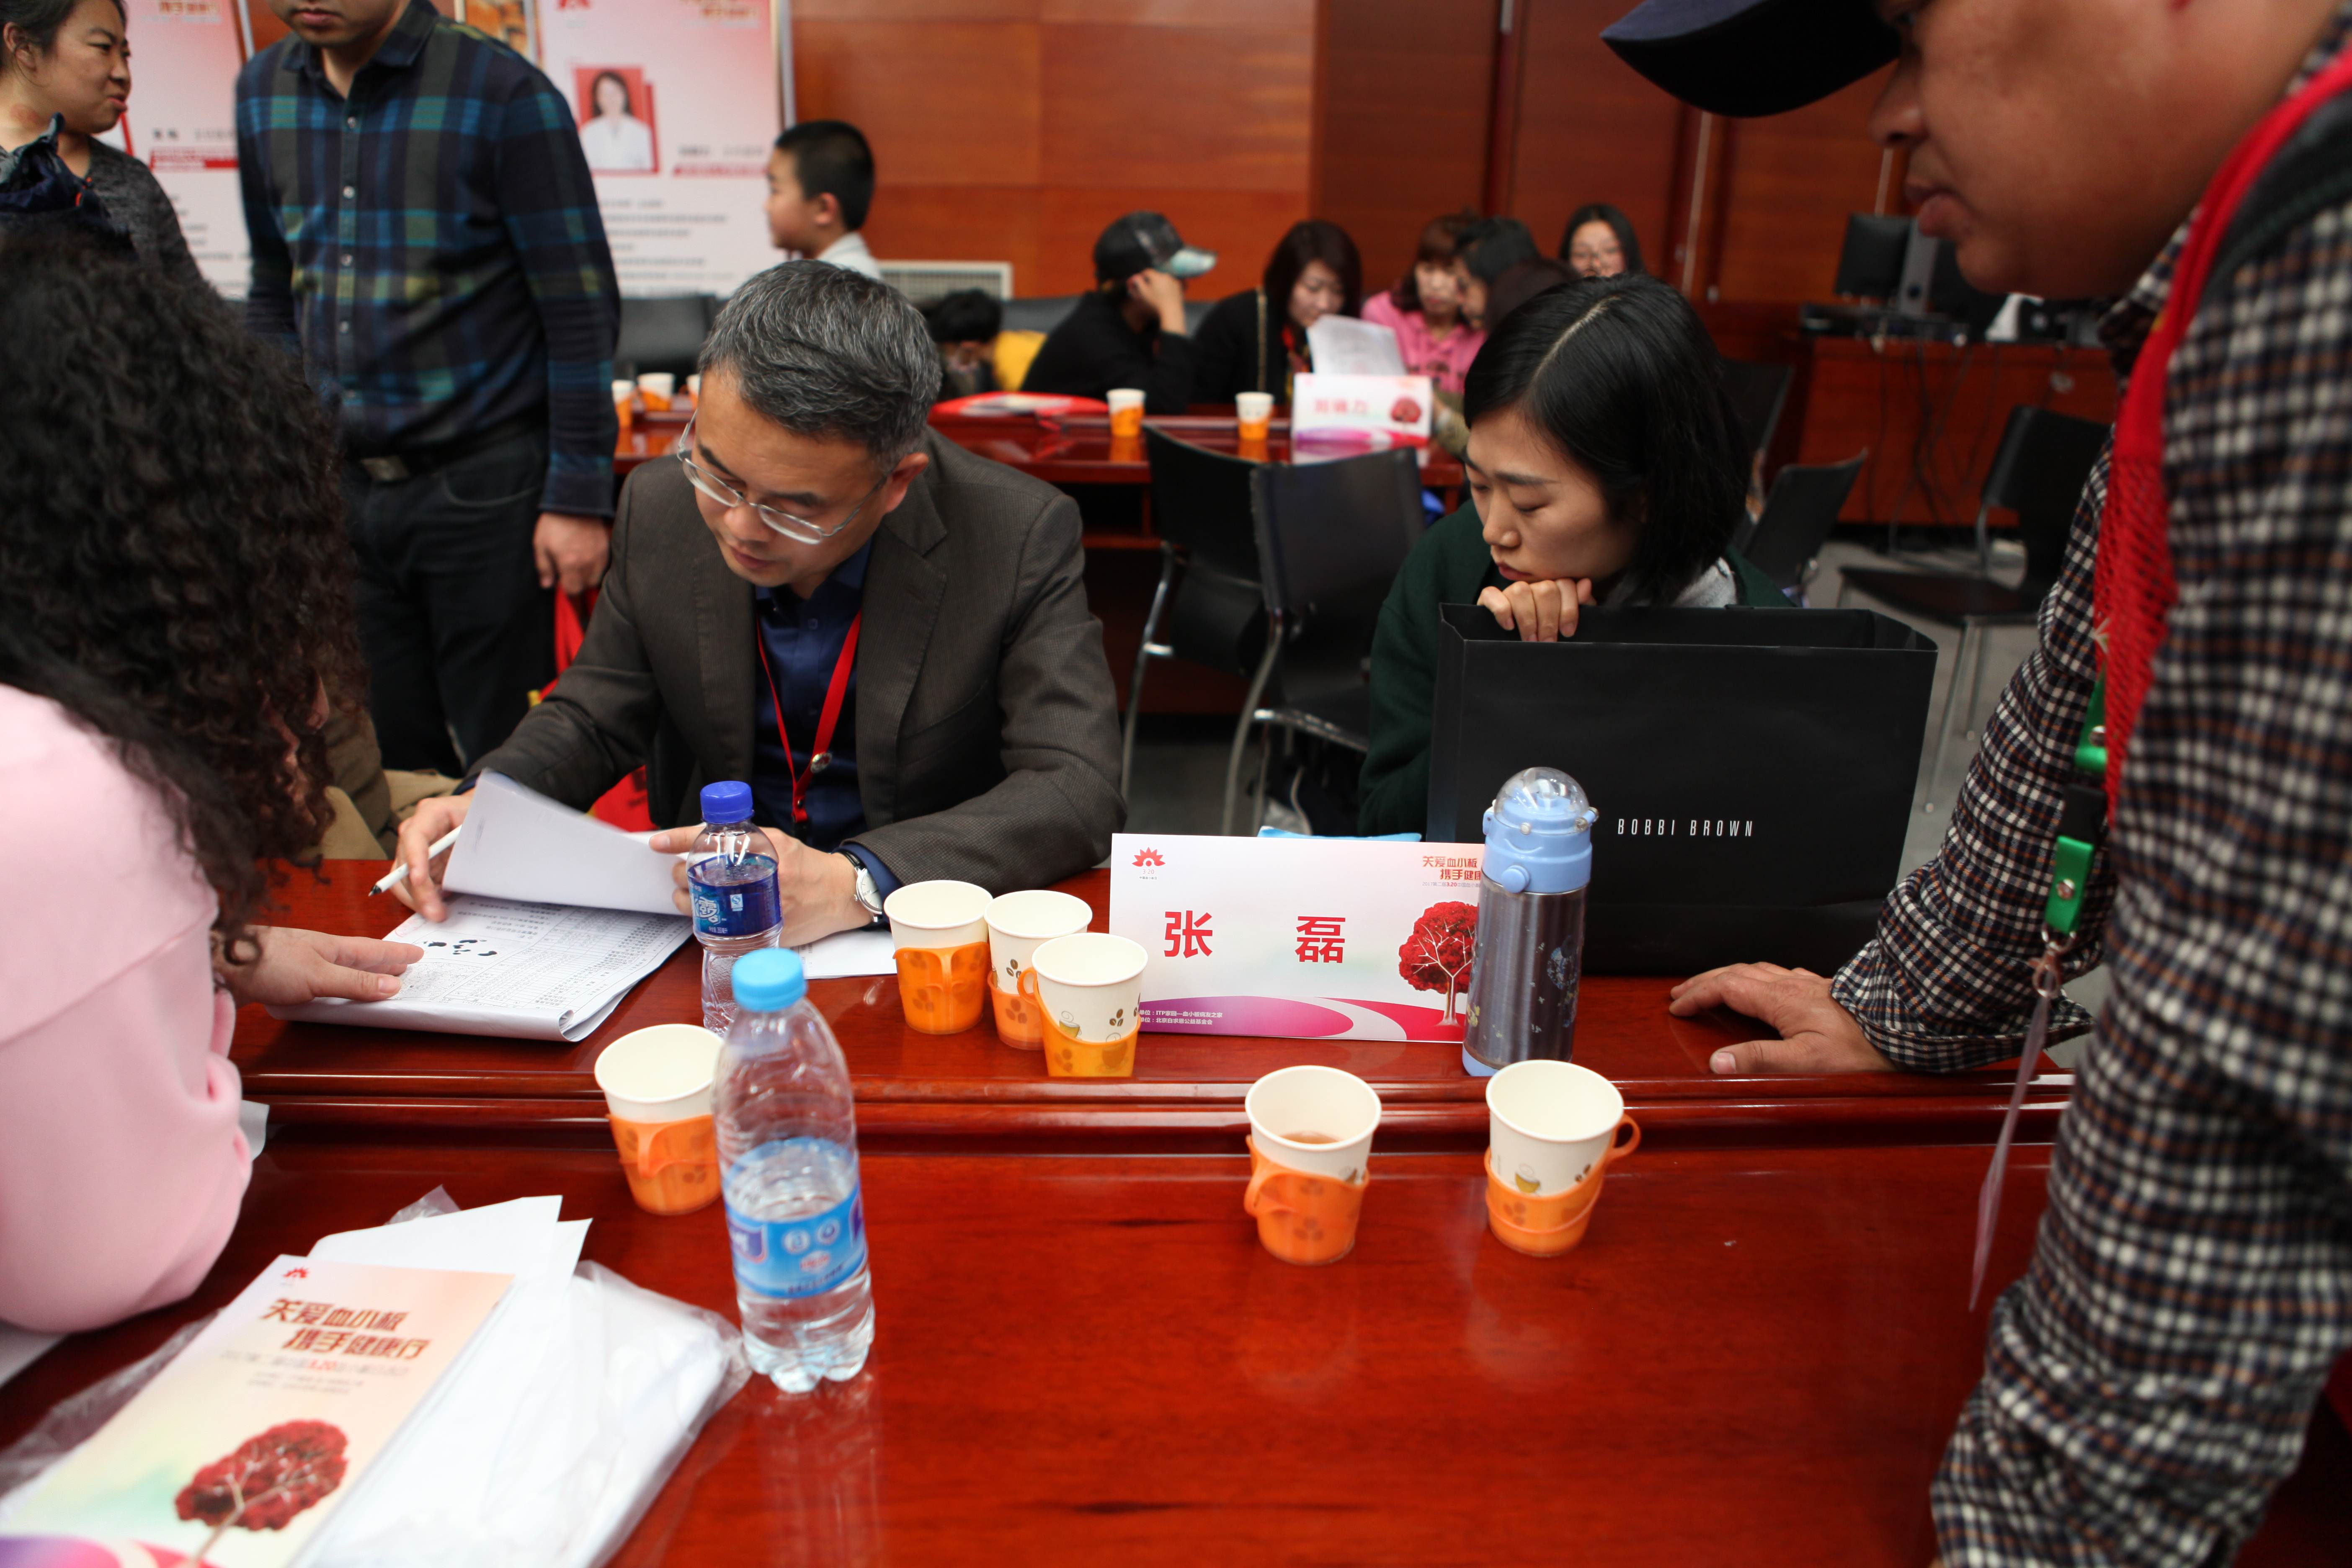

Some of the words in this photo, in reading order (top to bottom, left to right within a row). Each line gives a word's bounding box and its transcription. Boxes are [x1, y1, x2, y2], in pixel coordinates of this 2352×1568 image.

[1618, 819, 1675, 835] BOBBI
[1690, 820, 1752, 836] BROWN
[1422, 856, 1477, 868] 关爱血小板
[1164, 910, 1213, 959] 张
[1295, 916, 1346, 963] 磊
